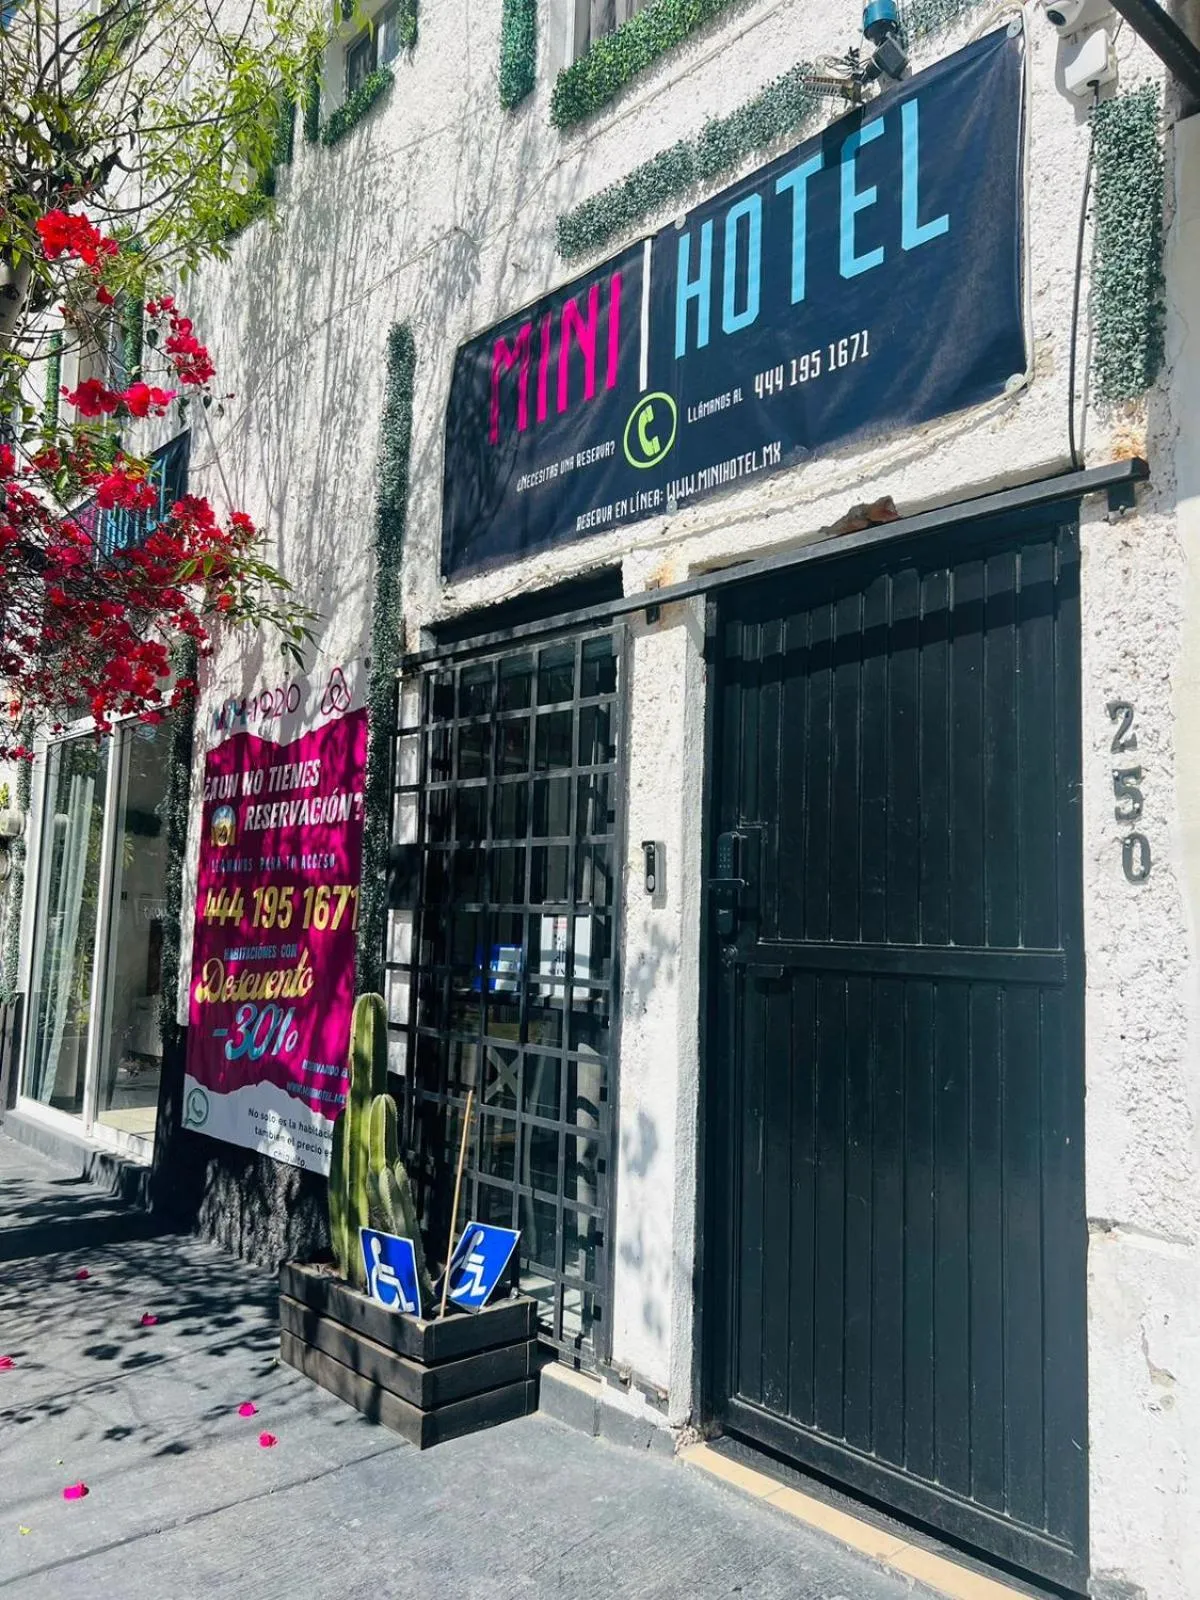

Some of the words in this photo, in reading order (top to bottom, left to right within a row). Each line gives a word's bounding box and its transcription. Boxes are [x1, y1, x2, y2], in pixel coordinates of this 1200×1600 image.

[487, 270, 624, 447] MINI
[673, 97, 951, 361] HOTEL
[732, 387, 744, 404] AL
[753, 364, 785, 400] 444
[789, 350, 821, 387] 195
[827, 329, 870, 373] 1671
[560, 459, 575, 476] UNA
[576, 440, 616, 469] RESERVA?
[575, 504, 613, 532] RESERVA
[615, 500, 628, 519] EN
[629, 488, 664, 514] LÍNEA:
[665, 440, 782, 502] WWW.MINIHOTEL.MX
[241, 771, 264, 797] NO
[268, 758, 322, 793] TIENES
[1105, 701, 1151, 885] 250
[243, 787, 364, 832] RESERVACIÓN?
[301, 852, 336, 870] ACCESO
[203, 887, 244, 926] 444
[252, 886, 295, 929] 195
[302, 884, 360, 931] 1671
[194, 947, 314, 1004] Descuento
[212, 1003, 299, 1061] -30%
[296, 1140, 322, 1156] precio
